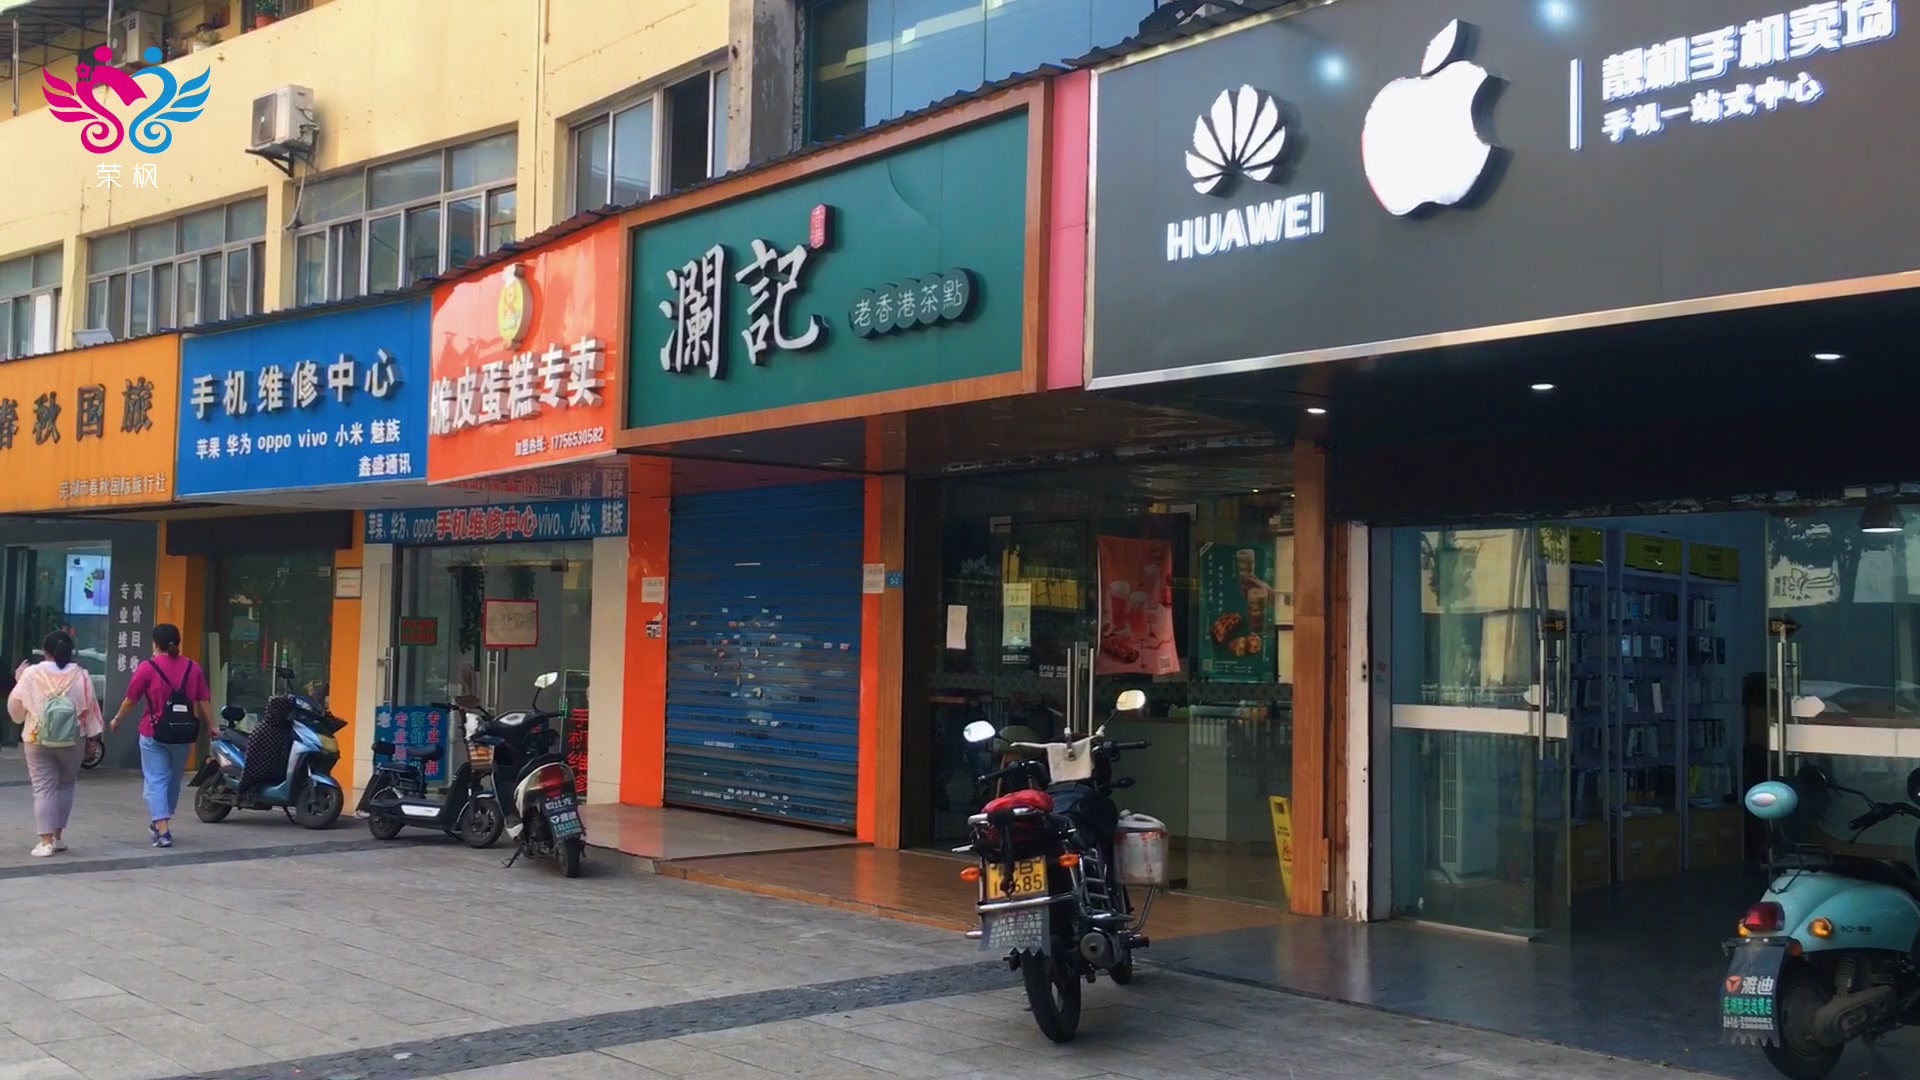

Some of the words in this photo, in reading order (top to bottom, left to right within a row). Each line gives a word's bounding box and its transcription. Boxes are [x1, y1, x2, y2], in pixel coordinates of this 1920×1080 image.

[1602, 71, 1823, 142] 手机一站式中心
[1167, 191, 1324, 261] HUAWEI
[854, 279, 962, 327] 老香港茶點
[190, 348, 397, 420] 手机维修中心
[429, 336, 604, 435] 脆皮蛋糕专卖
[196, 437, 220, 459] 苹果
[226, 433, 251, 455] 华为
[257, 432, 292, 453] oppo
[298, 429, 327, 448] vivo
[335, 421, 363, 447] 小米
[370, 419, 400, 444] 魅族
[551, 426, 604, 449] 17756530582
[358, 453, 411, 477] 鑫盛通讯
[434, 504, 538, 541] 手机维修中心
